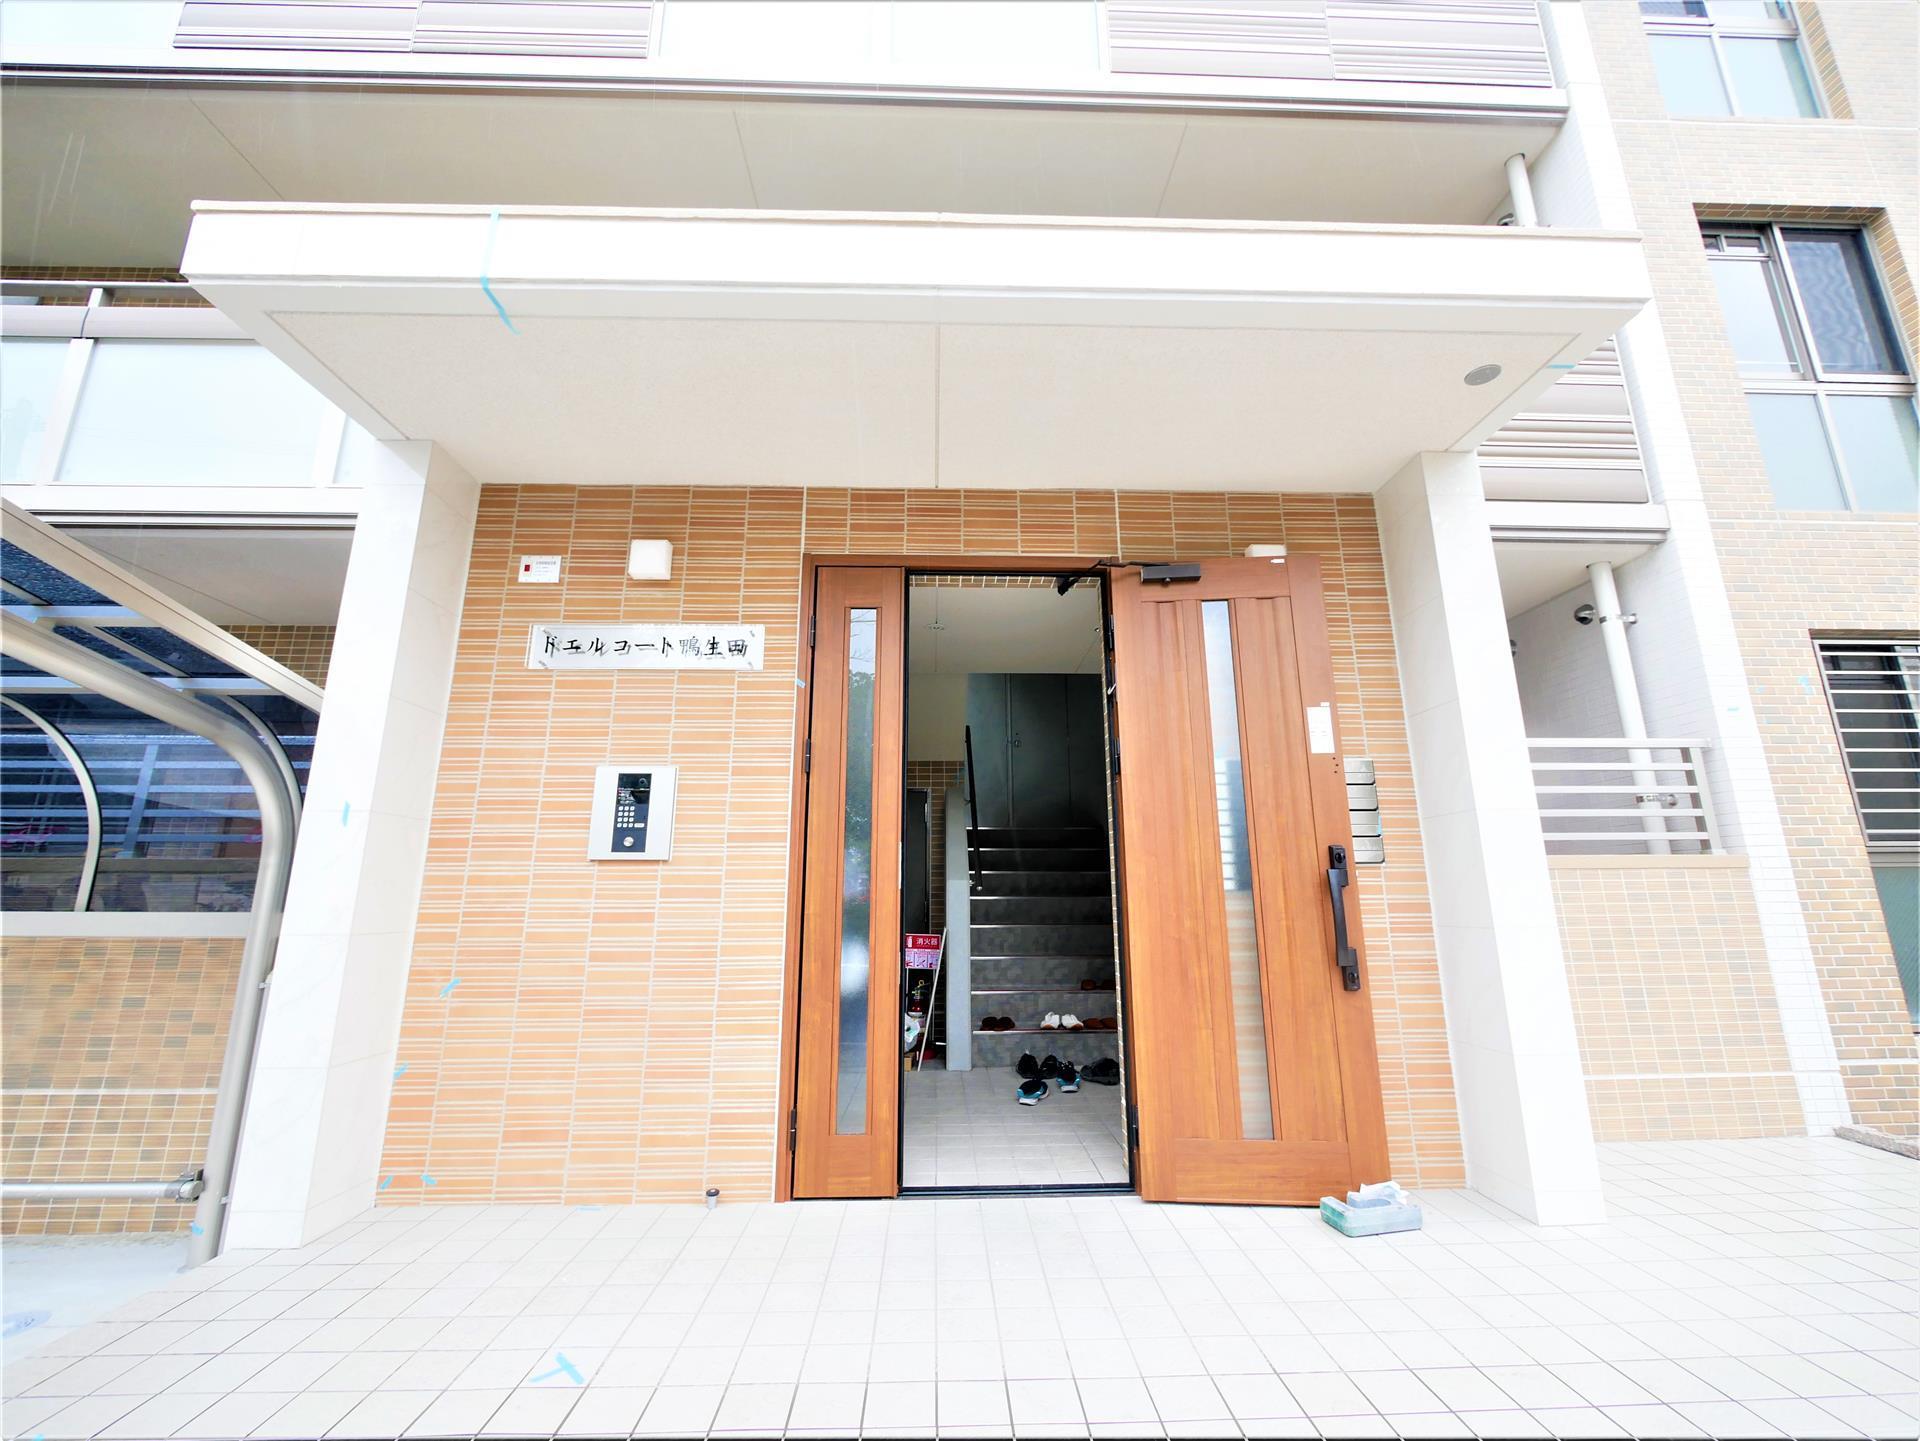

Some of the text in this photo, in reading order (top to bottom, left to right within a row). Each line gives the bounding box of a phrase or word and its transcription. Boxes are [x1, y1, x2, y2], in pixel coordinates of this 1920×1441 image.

[544, 635, 748, 659] ドエルコート鴨生田
[916, 937, 938, 946] 消火器
